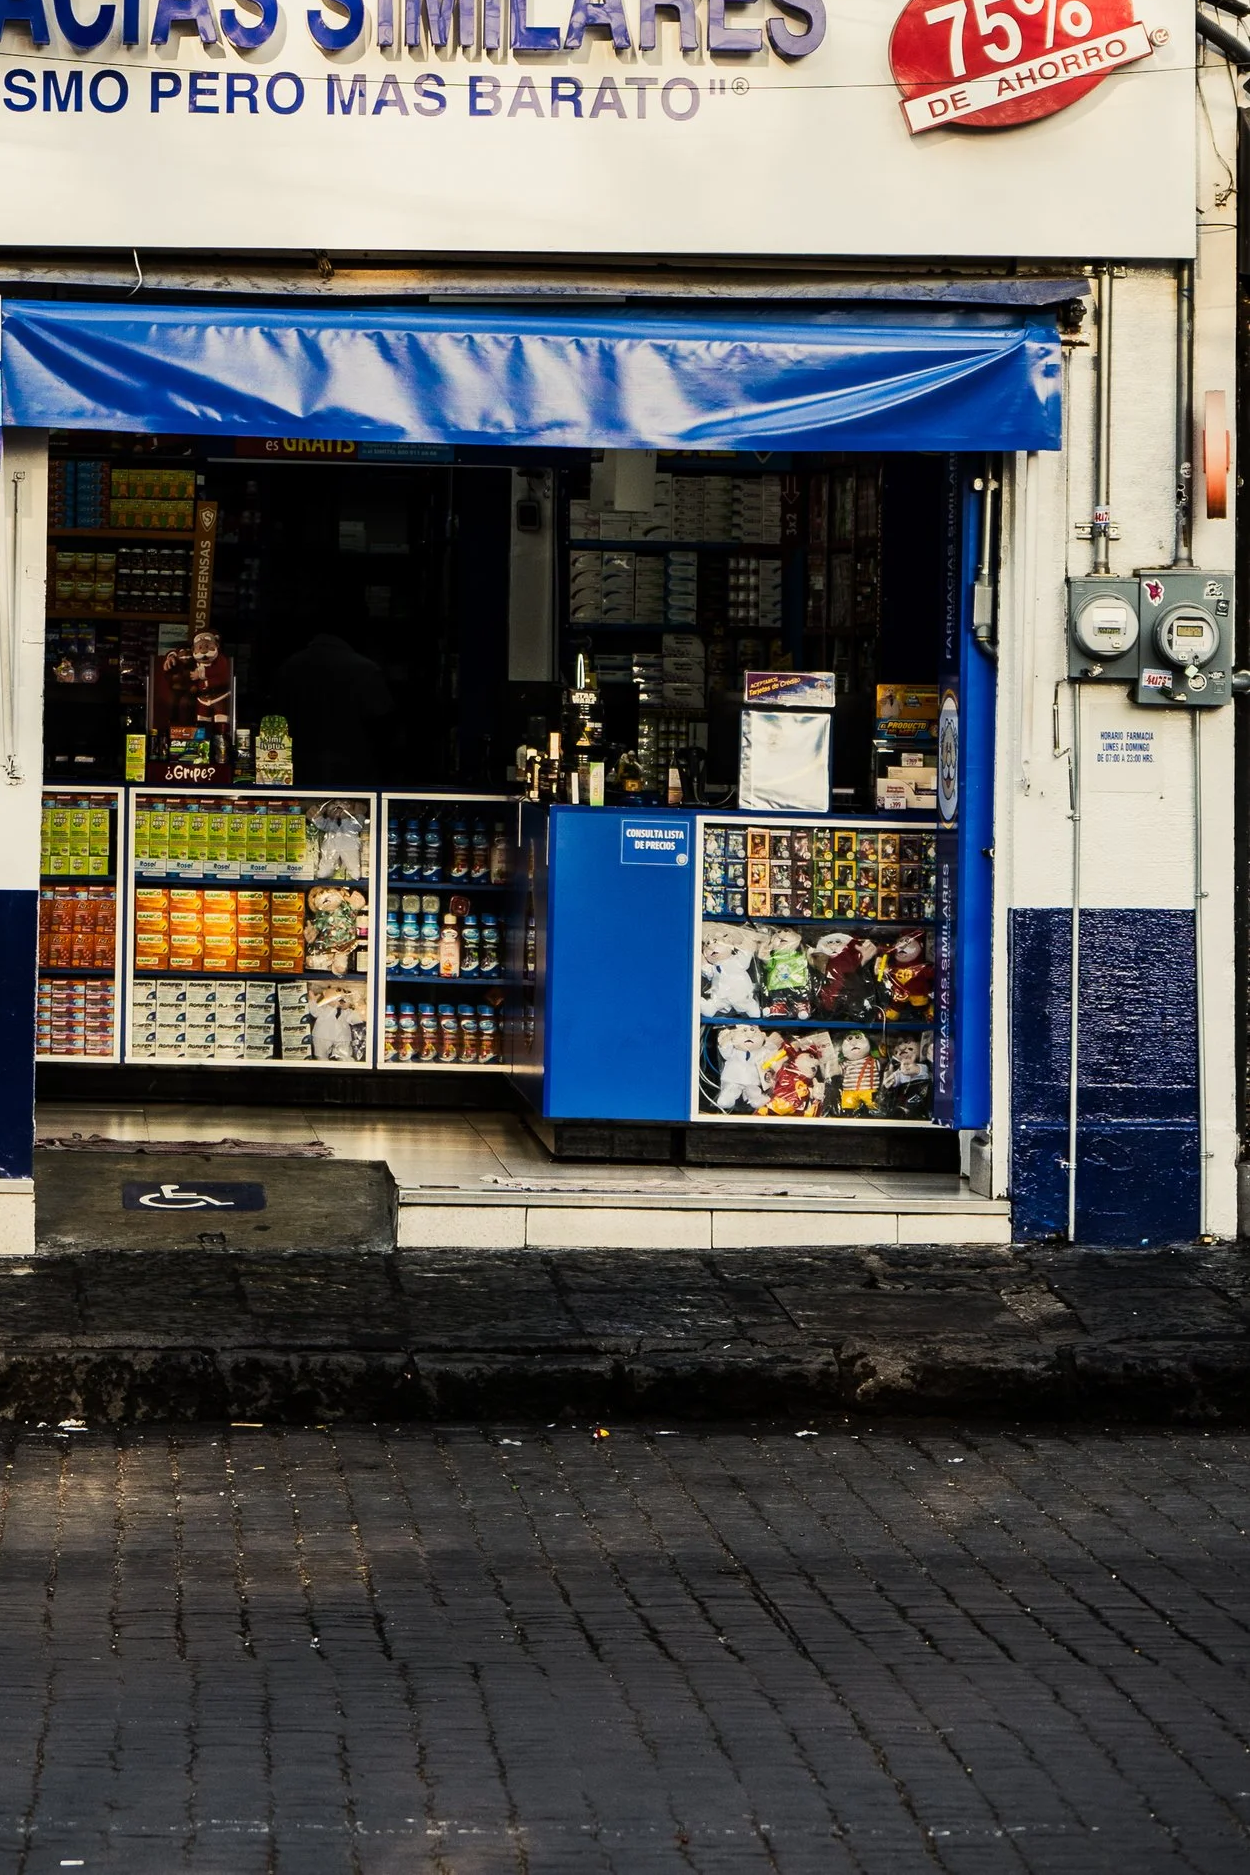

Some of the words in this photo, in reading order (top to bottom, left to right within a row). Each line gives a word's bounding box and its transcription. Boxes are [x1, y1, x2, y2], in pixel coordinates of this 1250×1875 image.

[927, 90, 971, 122] DE
[995, 37, 1132, 98] AHORRO
[150, 70, 305, 116] PERO
[327, 72, 448, 118] MAS
[265, 439, 279, 451] es
[196, 540, 212, 609] DEFENSAS
[945, 544, 955, 660] FARMACIAS
[194, 611, 207, 633] US
[571, 697, 598, 705] WARS
[887, 721, 927, 730] PRODUCTO
[1100, 732, 1124, 740] HORARIO
[1126, 732, 1154, 740] FARMACIA
[1102, 743, 1120, 751] LUNES
[1120, 743, 1124, 751] A
[1125, 743, 1150, 751] DOMINGO
[1097, 754, 1104, 762] DE
[164, 764, 216, 781] ¿Gripe?
[625, 828, 664, 839] CONSULTA
[664, 829, 685, 840] LISTA
[634, 840, 645, 850] DE
[645, 841, 676, 851] PRECIOS
[940, 862, 950, 971] SIMILARES
[939, 977, 949, 1094] FARMACIAS
